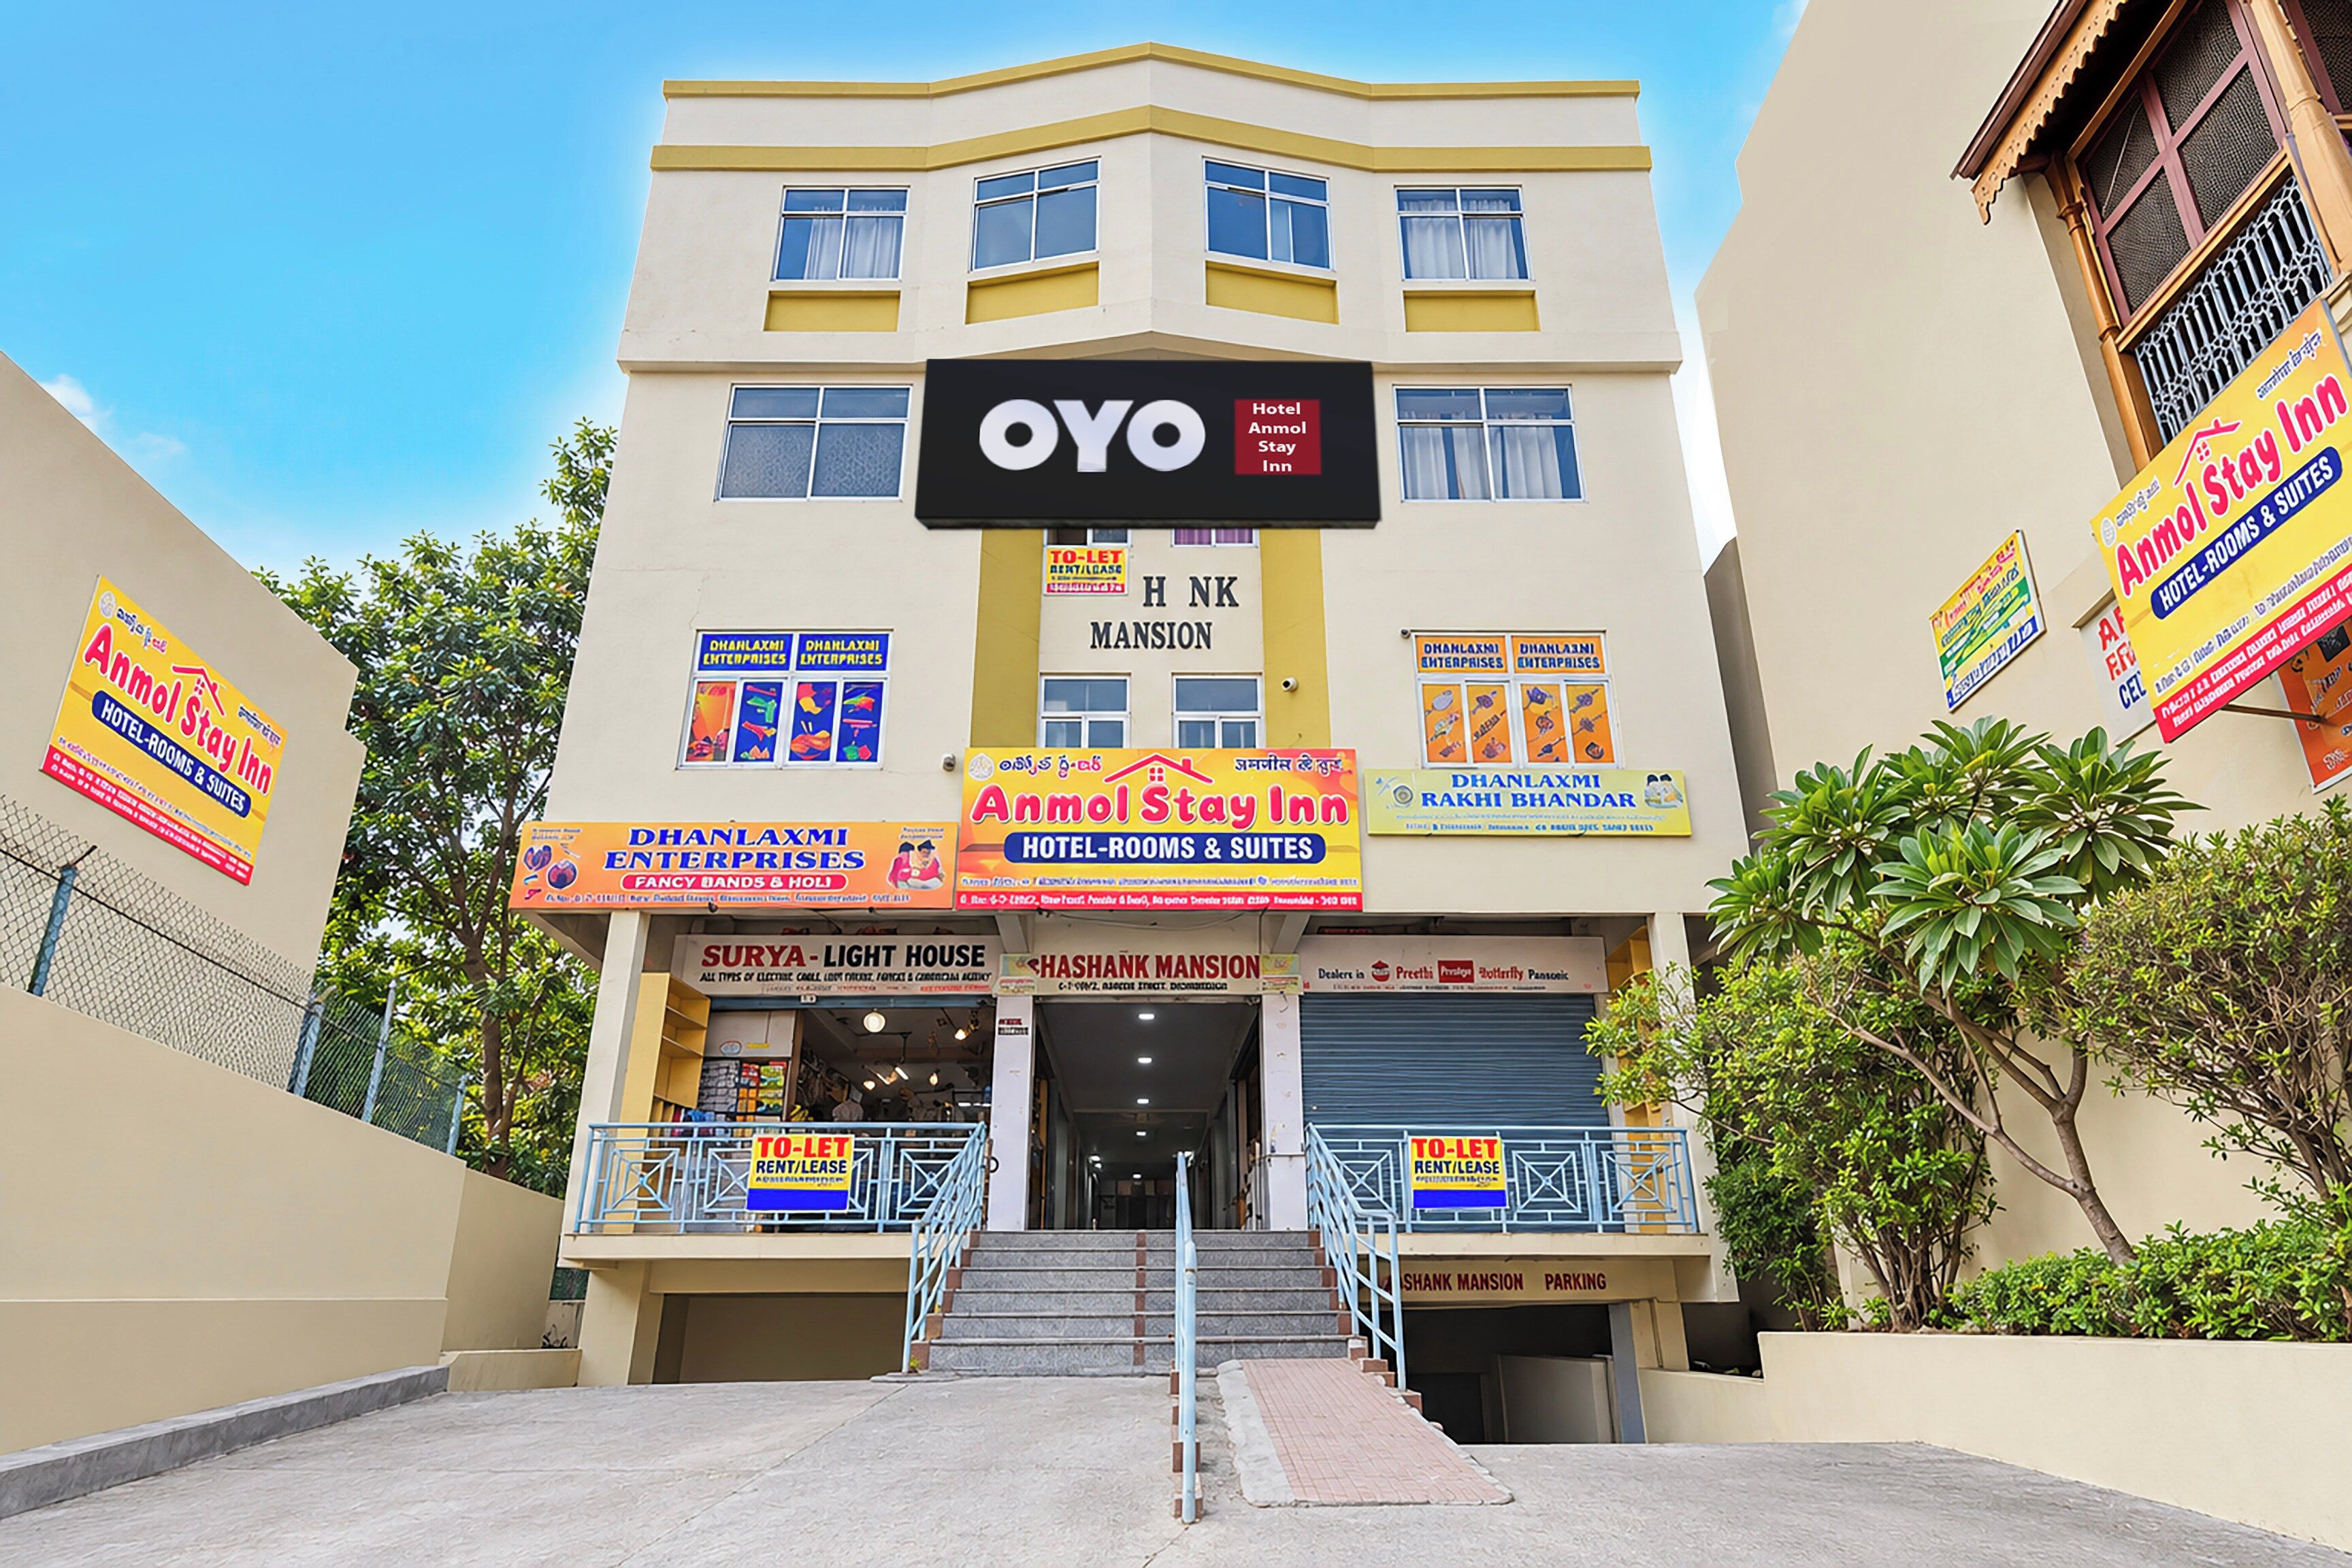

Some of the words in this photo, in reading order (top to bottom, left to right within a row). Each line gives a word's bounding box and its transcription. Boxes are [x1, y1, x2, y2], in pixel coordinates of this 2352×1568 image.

[1252, 402, 1301, 415] Hotel
[979, 399, 1205, 472] OYO
[1248, 421, 1307, 434] Anmol
[1258, 440, 1296, 456] Stay
[1262, 459, 1292, 472] Inn
[2114, 481, 2207, 597] Anmol
[2202, 427, 2282, 517] Stay
[2276, 374, 2347, 453] Inn
[2158, 515, 2260, 612] HOTEL-ROOMS
[2262, 506, 2276, 528] &
[2277, 456, 2333, 516] SUITES
[1051, 550, 1122, 564] TO-LET
[1090, 621, 1213, 649] MANSION
[83, 624, 182, 723] Anmol
[180, 696, 238, 774] Stay
[237, 737, 273, 796] Inn
[101, 699, 194, 777] HOTEL-ROOMS
[194, 766, 206, 785] &
[206, 774, 246, 812] SUITES
[1451, 773, 1601, 789] DHANLAXMI
[971, 784, 1128, 825] Anmol
[1140, 785, 1256, 829] Stay
[1269, 784, 1350, 825] Inn
[1421, 792, 1501, 808] RAKHI
[1510, 792, 1636, 808] BHANDAR
[628, 828, 848, 847] DHANLAXMI
[1022, 836, 1195, 860] HOTEL-ROOMS
[1203, 836, 1222, 860] &
[1230, 836, 1314, 860] SUITES
[604, 851, 865, 870] ENTERPRISES
[634, 876, 696, 889] FANCY
[788, 876, 832, 889] HOLI
[823, 944, 897, 968] LIGHT
[904, 944, 985, 968] HOUSE
[1155, 954, 1260, 979] MANSION
[757, 1137, 851, 1158] TO-LET
[1411, 1138, 1497, 1158] TO-LET
[755, 1160, 847, 1174] RENT/LEASE
[1414, 1160, 1500, 1174] RENT/LEASE
[1456, 1273, 1524, 1291] MANSION
[1544, 1273, 1607, 1291] PARKING
